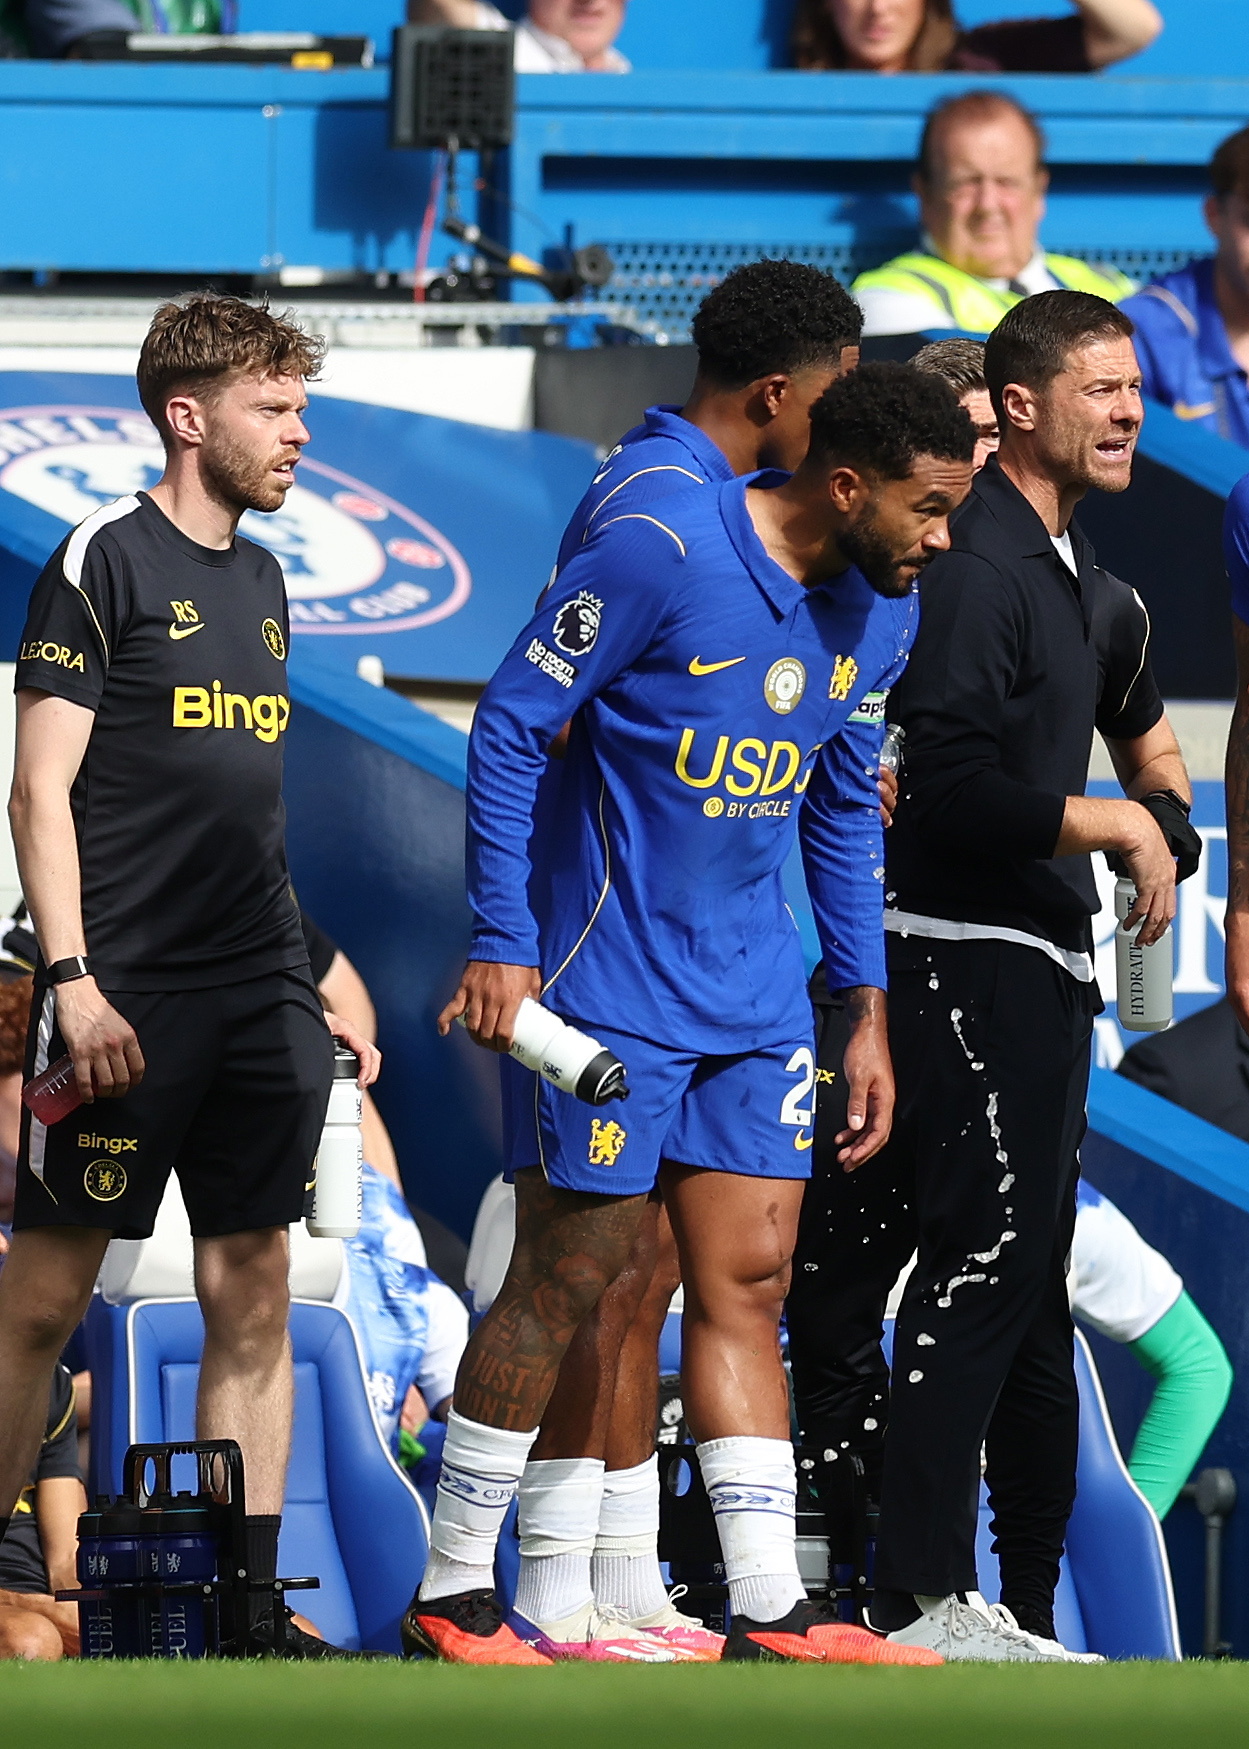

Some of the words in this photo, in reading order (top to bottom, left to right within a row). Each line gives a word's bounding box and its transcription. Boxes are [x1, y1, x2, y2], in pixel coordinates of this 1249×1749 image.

[169, 600, 199, 623] RS
[527, 638, 547, 657] No
[544, 650, 576, 677] room
[727, 802, 747, 818] BY
[748, 800, 791, 819] CIRCLE
[780, 1047, 817, 1126] 2
[78, 1132, 138, 1154] Bingx
[168, 1605, 187, 1657] UEL
